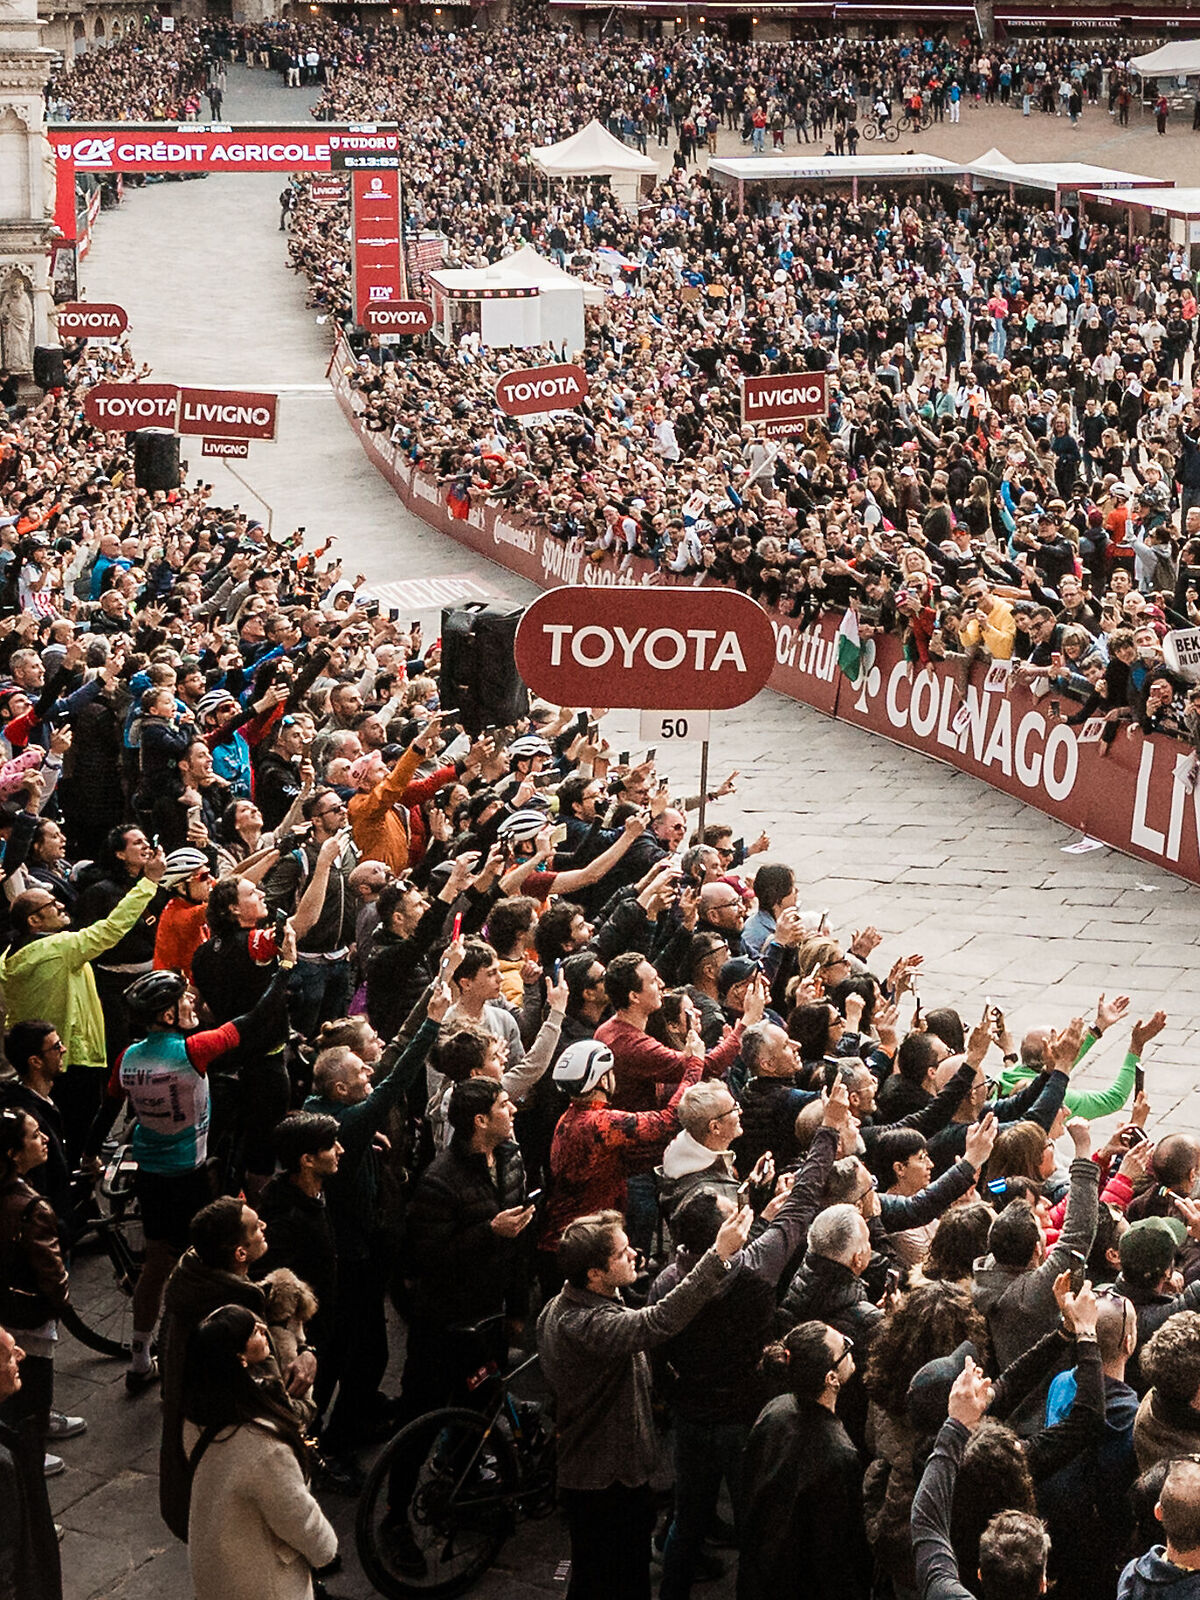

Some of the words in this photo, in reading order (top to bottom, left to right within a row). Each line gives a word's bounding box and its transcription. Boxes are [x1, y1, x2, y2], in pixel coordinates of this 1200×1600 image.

[117, 140, 207, 161] CRÉDIT
[209, 144, 331, 161] AGRICOLE
[341, 137, 386, 149] TUDOR
[60, 312, 121, 327] TOYOTA
[369, 311, 427, 325] TOYOTA
[503, 376, 580, 402] TOYOTA
[748, 386, 821, 408] LIVIGNO
[95, 398, 177, 417] TOYOTA
[184, 403, 270, 427] LIVIGNO
[767, 423, 804, 435] LIVIGNO
[203, 443, 247, 456] LIVIGNO
[542, 624, 747, 673] TOYOTA
[1178, 654, 1188, 666] IN
[660, 717, 688, 739] 50
[886, 660, 1079, 802] COLNAGO
